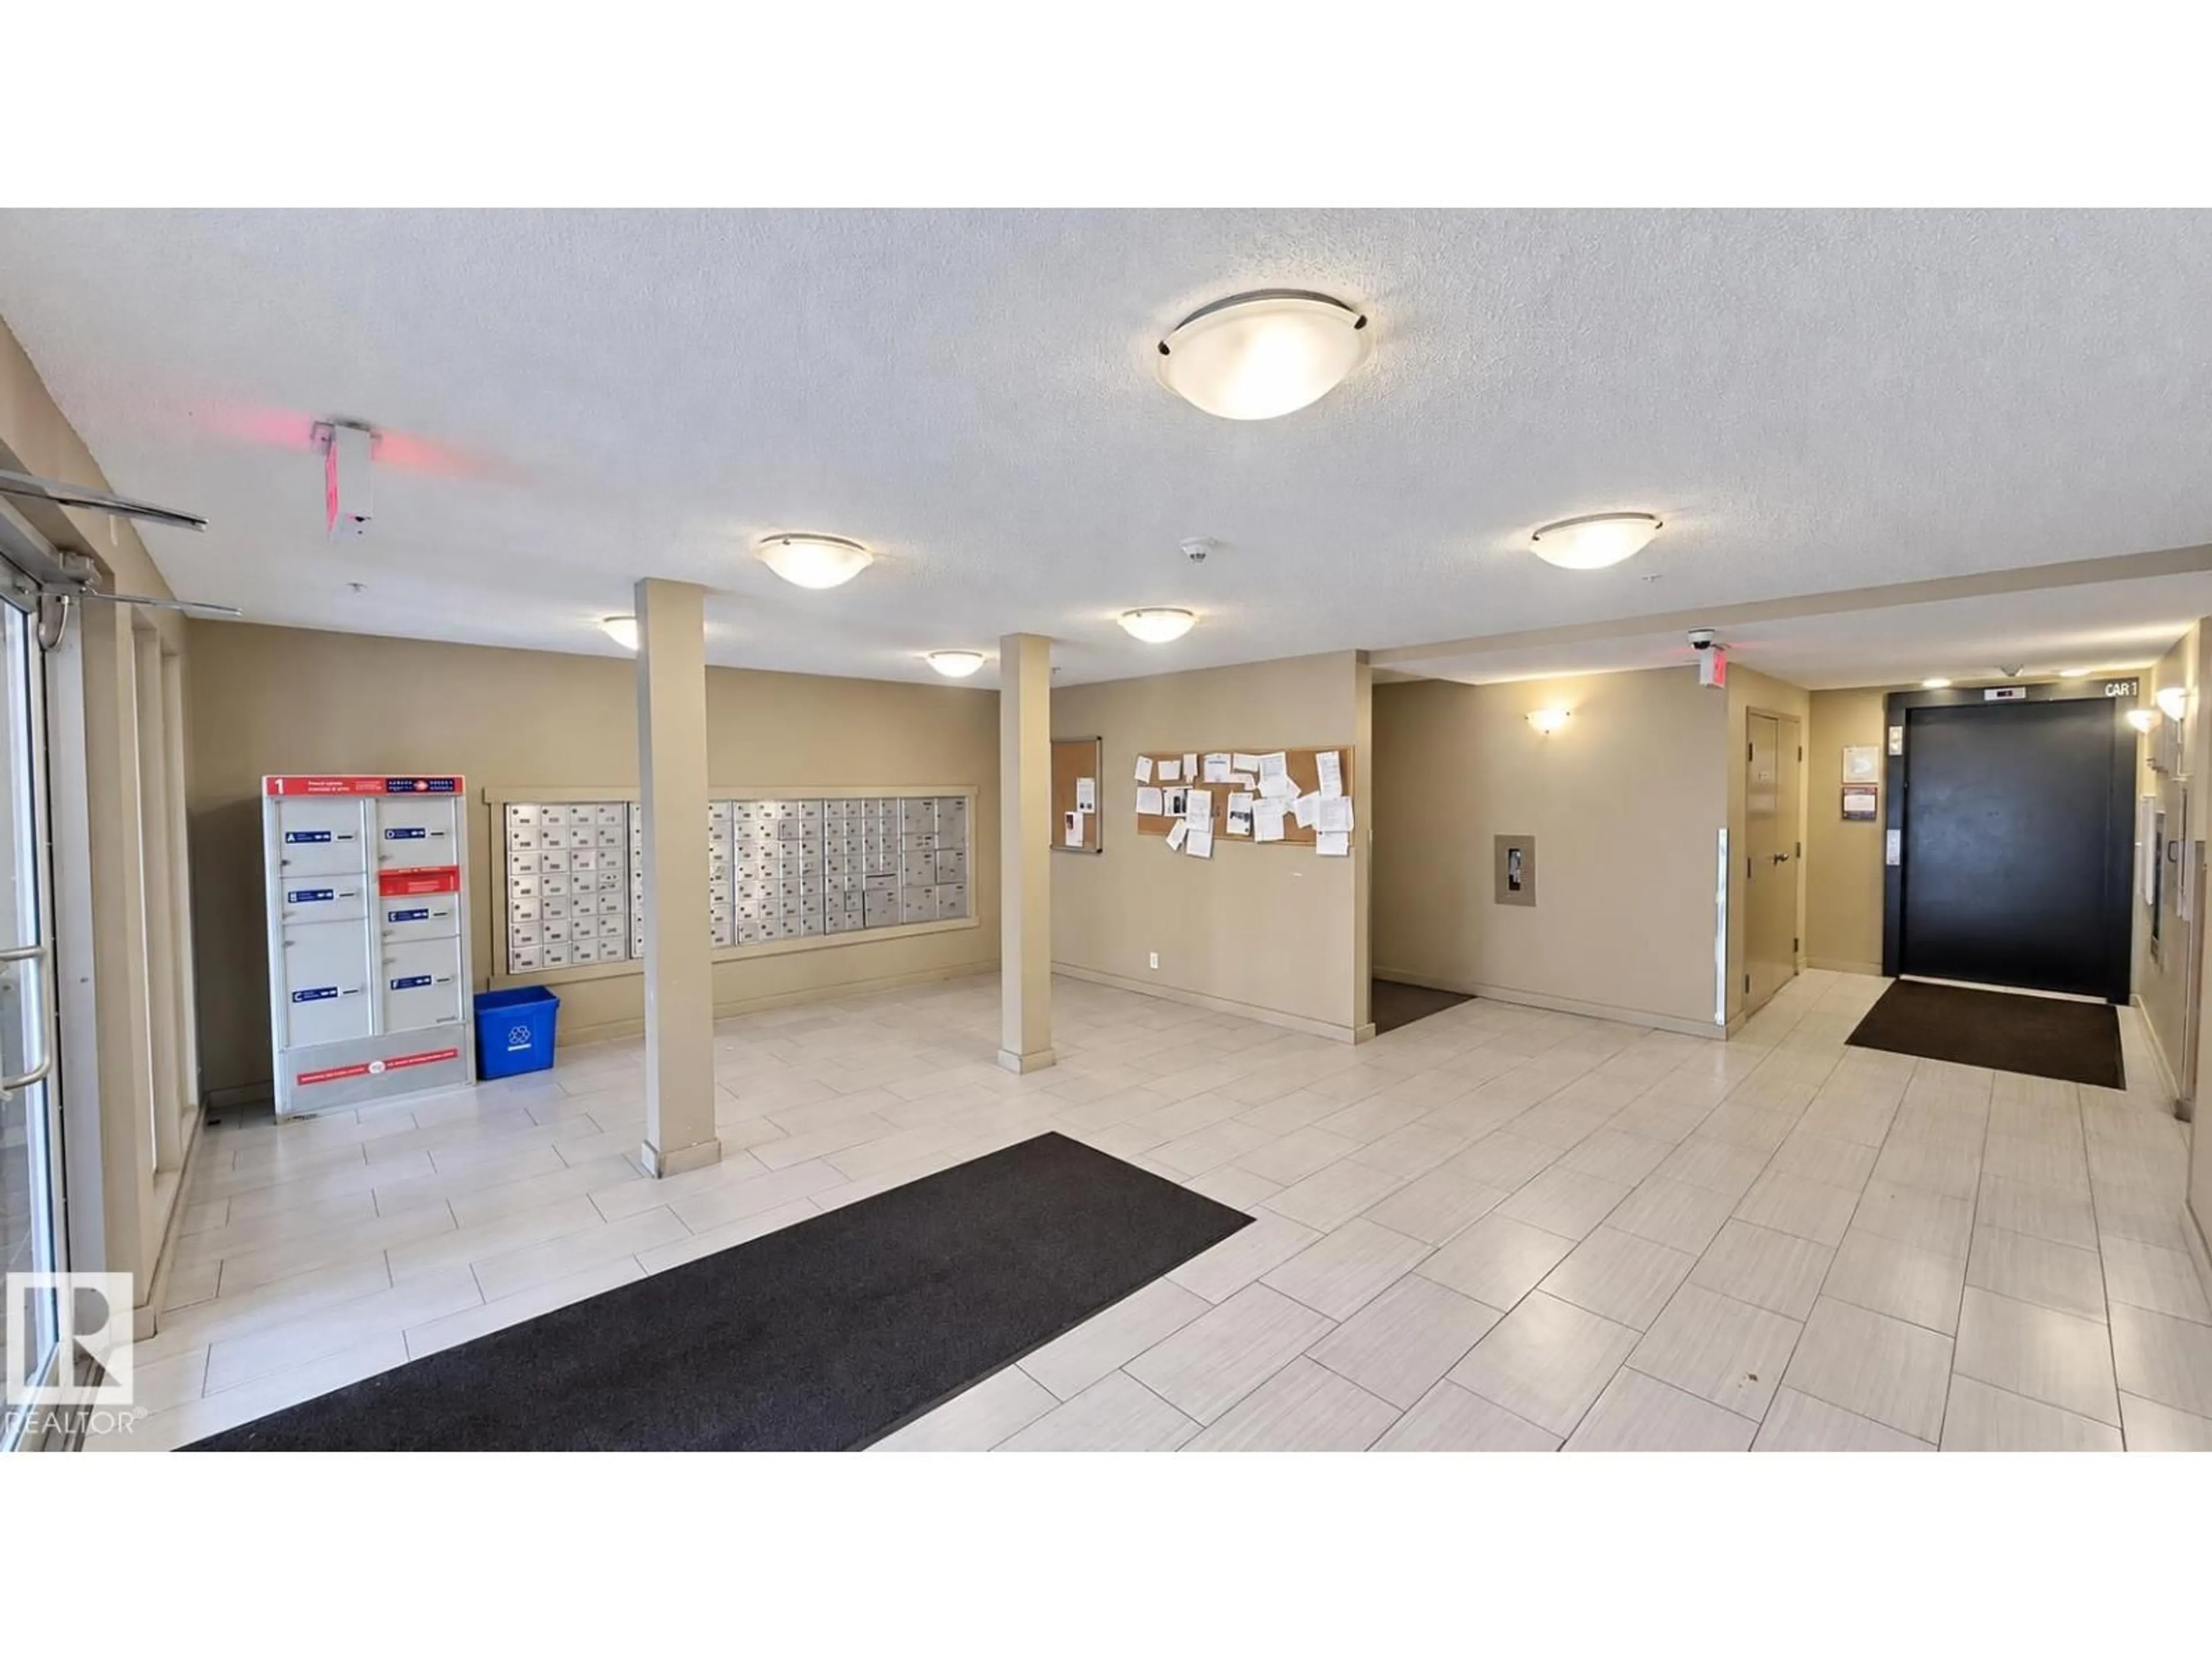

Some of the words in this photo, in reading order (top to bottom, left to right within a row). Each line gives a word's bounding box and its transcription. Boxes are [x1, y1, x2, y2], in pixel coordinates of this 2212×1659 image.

[2105, 683, 2129, 696] CAR
[2131, 681, 2137, 695] 1
[275, 779, 283, 794] 1
